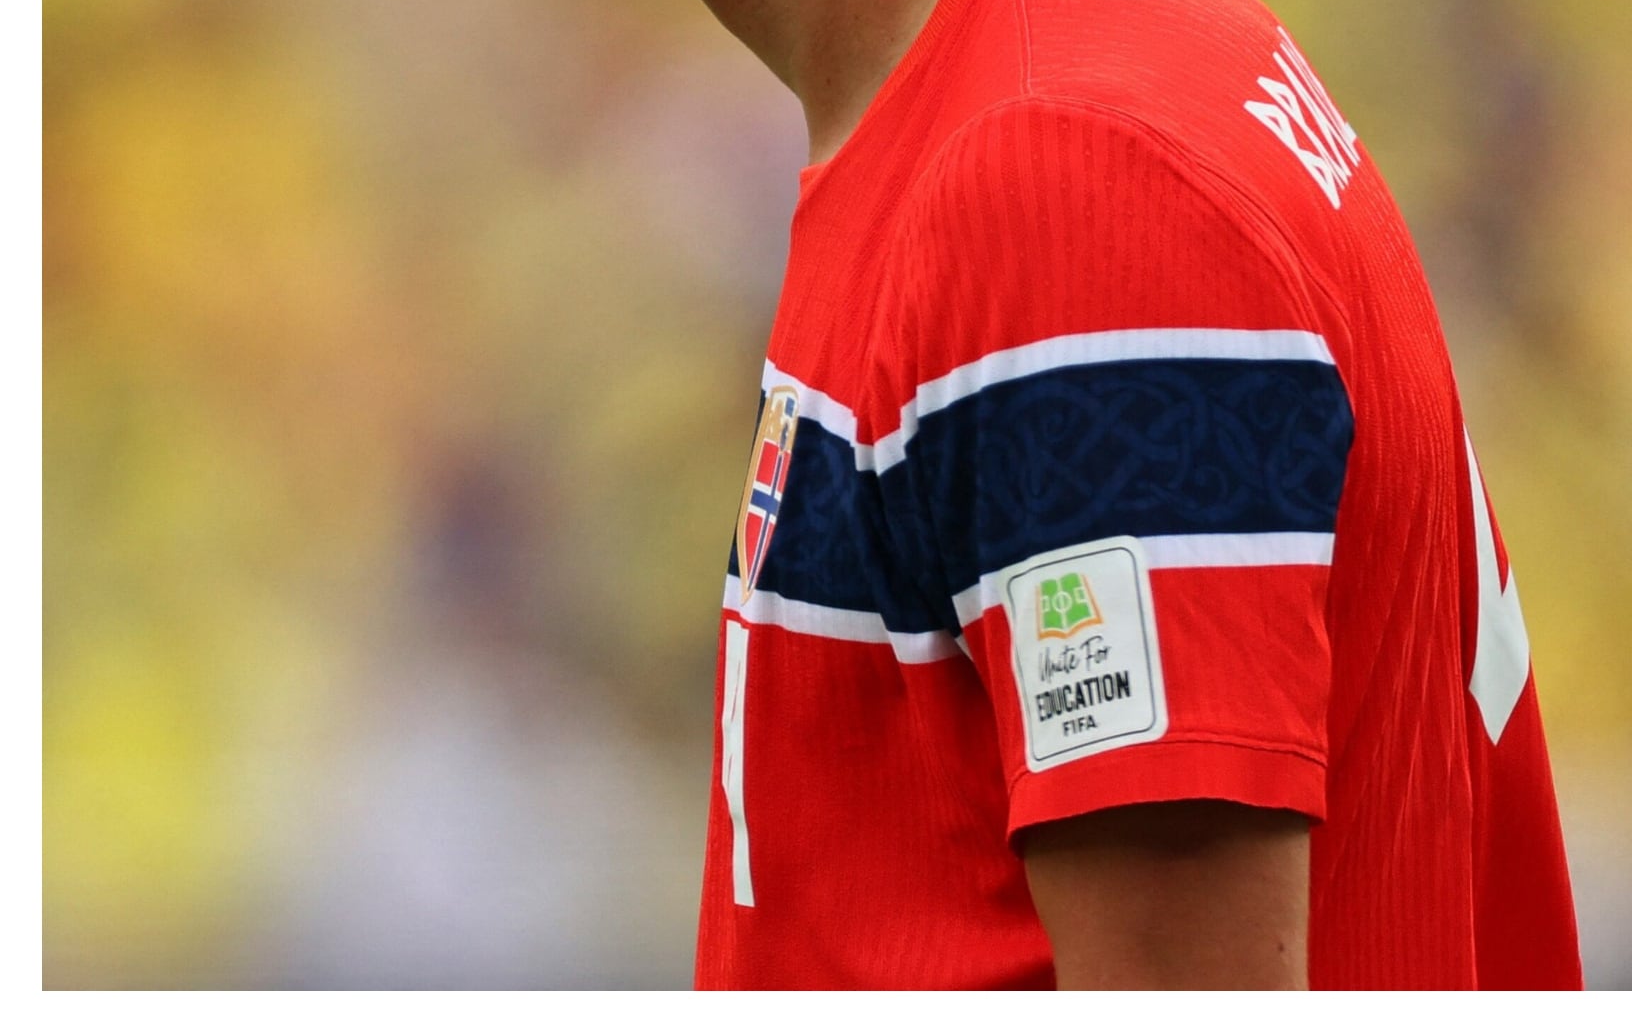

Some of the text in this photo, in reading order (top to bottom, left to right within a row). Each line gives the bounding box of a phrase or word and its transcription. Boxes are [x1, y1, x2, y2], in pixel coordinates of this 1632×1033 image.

[1039, 634, 1112, 683] Unite For
[1035, 669, 1132, 723] EDUCATION
[1063, 714, 1098, 737] FIFA
